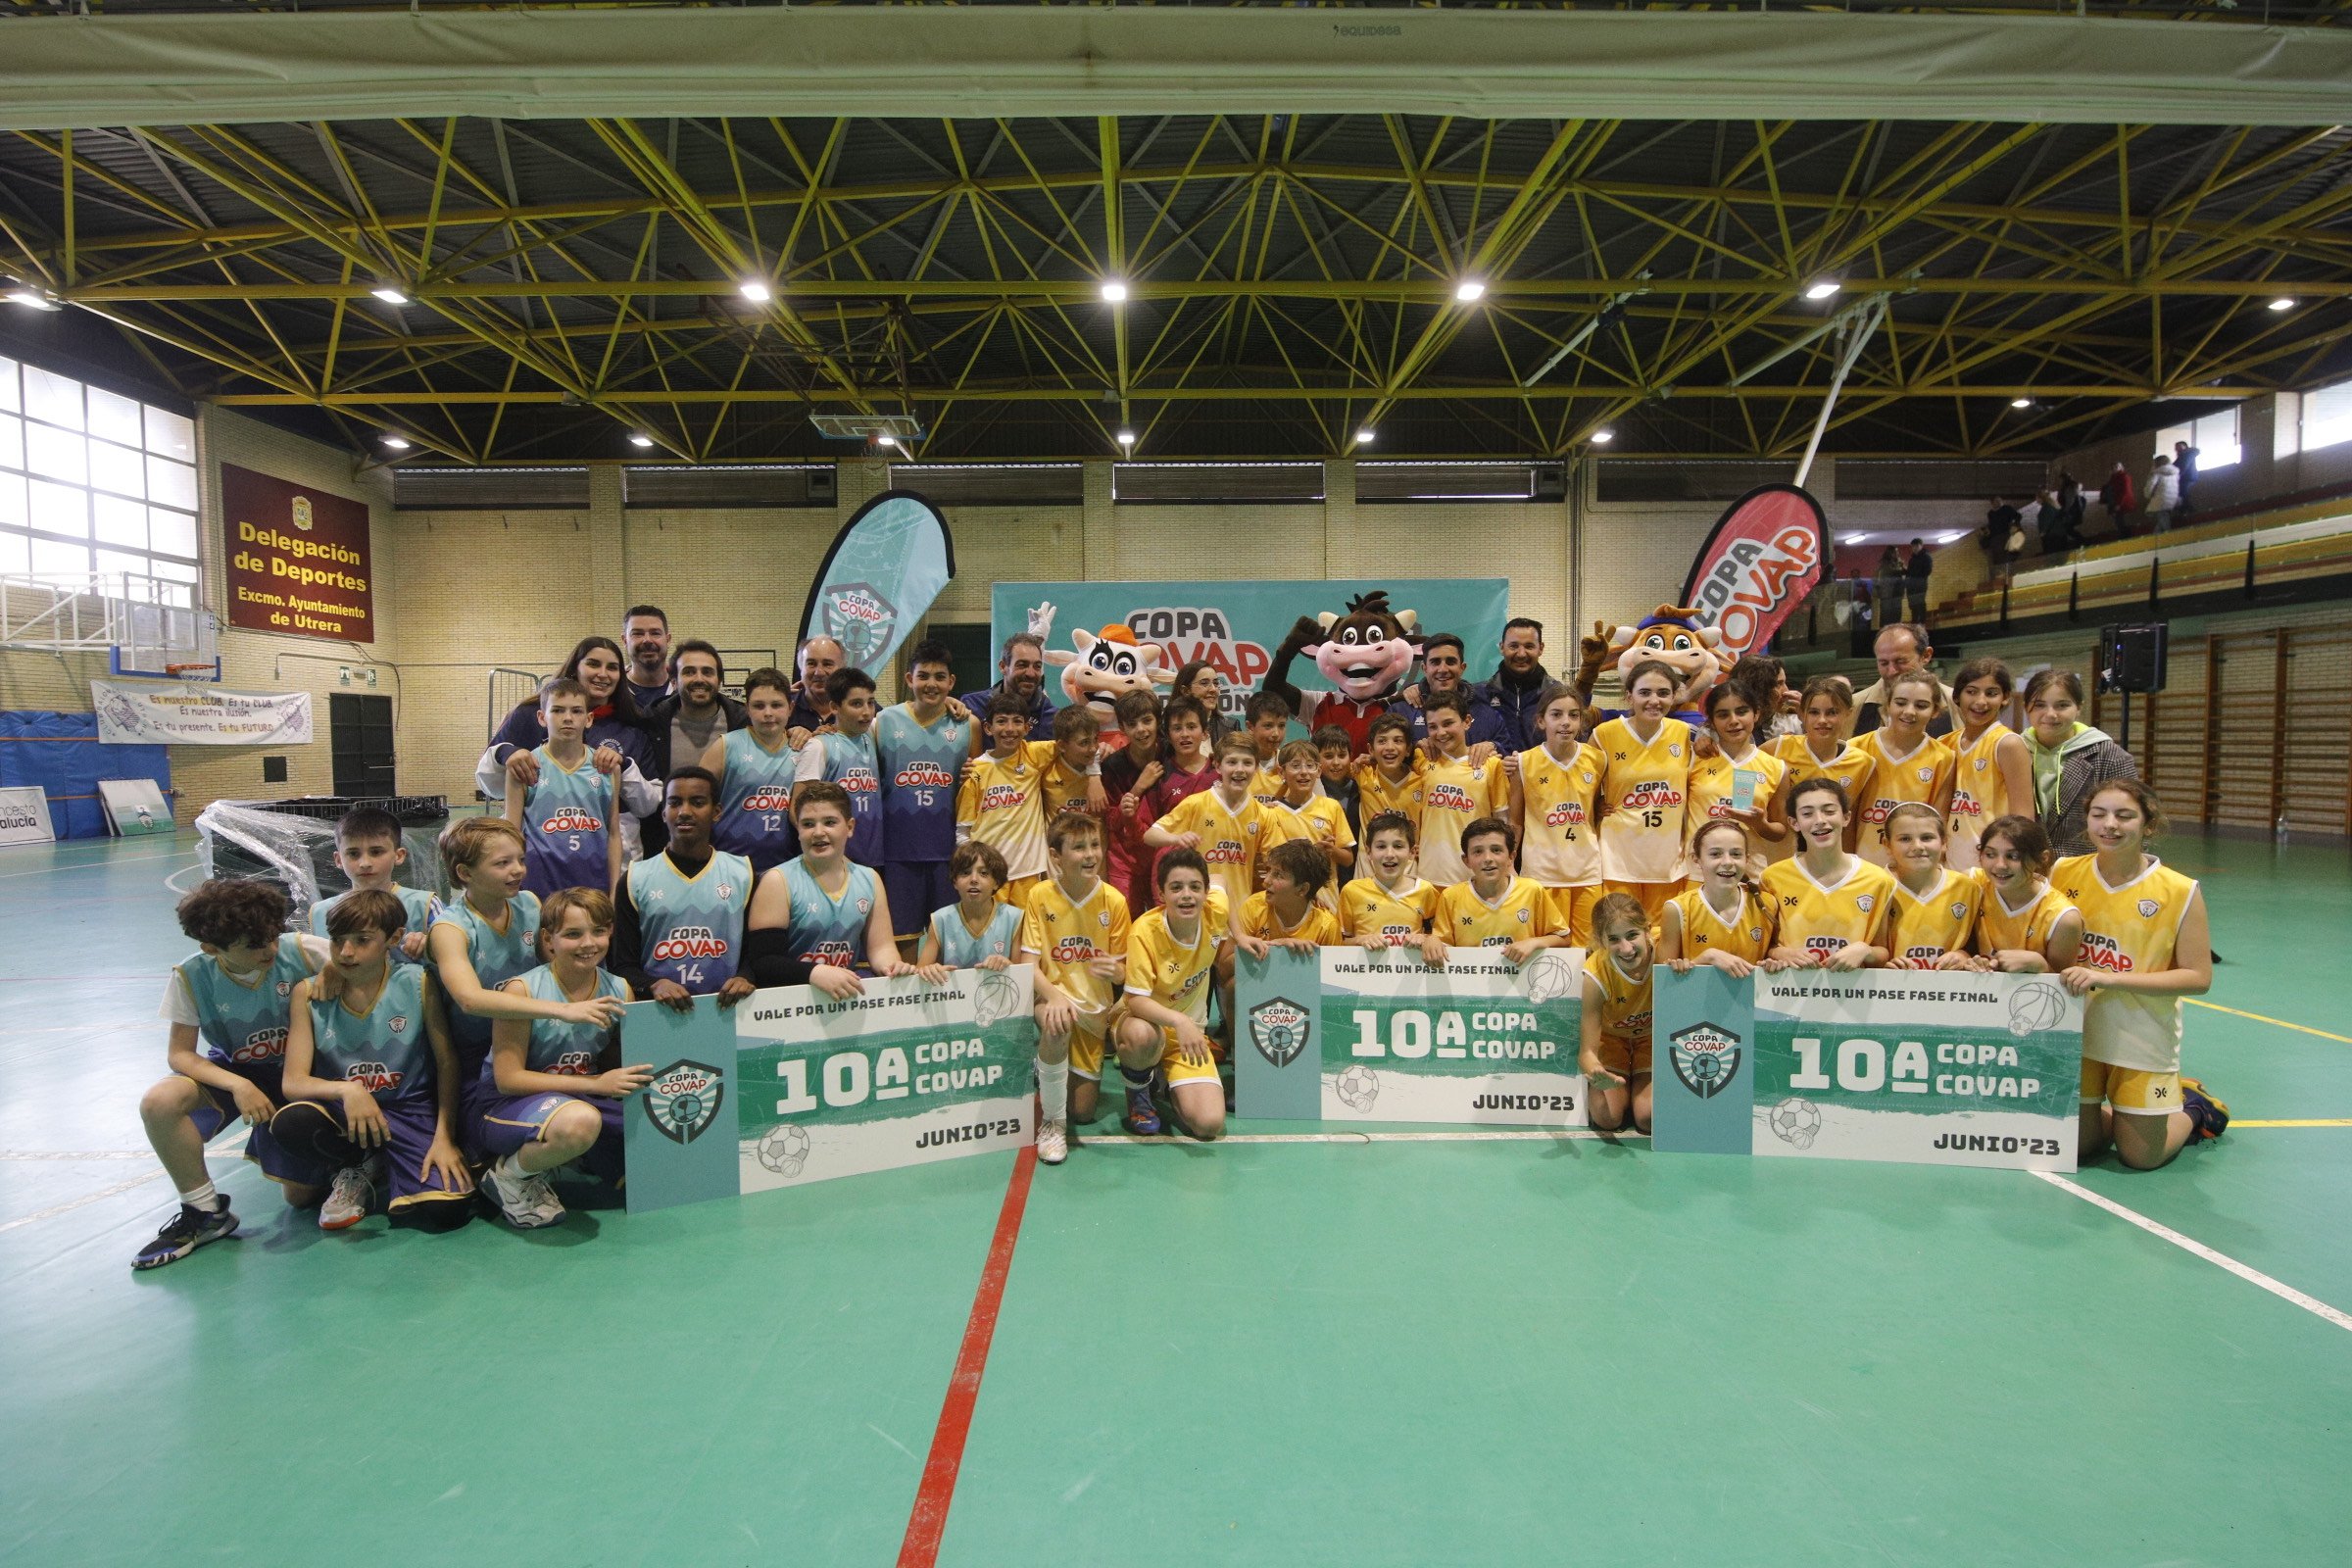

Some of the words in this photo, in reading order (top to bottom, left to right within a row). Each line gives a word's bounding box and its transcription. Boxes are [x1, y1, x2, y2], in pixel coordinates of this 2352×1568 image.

[239, 521, 361, 565] Delegación
[234, 551, 265, 572] de
[271, 557, 367, 592] Deportes
[1694, 543, 1763, 627] COPA
[238, 586, 286, 607] Excmo.
[288, 595, 366, 618] Ayuntamiento
[850, 595, 874, 610] COPA
[839, 601, 881, 621] COVAP
[270, 612, 290, 626] de
[295, 614, 342, 633] Utrera
[1128, 612, 1226, 639] COPA
[1140, 642, 1269, 685] VAP
[149, 695, 161, 704] Es
[164, 696, 198, 705] nuestro
[180, 706, 189, 715] Es
[191, 707, 222, 716] nuestra
[179, 723, 216, 734] presente.
[219, 722, 227, 731] Es
[909, 762, 940, 771] COPA
[895, 771, 953, 786] COVAP
[758, 786, 788, 796] COPA
[988, 785, 1014, 796] COPA
[1436, 785, 1464, 796] COPA
[1636, 782, 1669, 792] COPA
[744, 796, 790, 810] COVA
[914, 790, 934, 806] 15
[1428, 793, 1474, 810] COVAP
[1623, 791, 1682, 808] COVAP
[1953, 791, 1970, 800] PA
[856, 796, 868, 812] 11
[1875, 800, 1896, 808] COP
[1951, 800, 1981, 815] VAP
[557, 808, 587, 817] COPA
[1642, 811, 1663, 828] 15
[543, 817, 601, 832] COVAP
[761, 815, 781, 831] 12
[1565, 828, 1576, 841] 4
[568, 835, 580, 851] 5
[671, 929, 710, 940] COPA
[1061, 937, 1092, 948] COPA
[1483, 937, 1513, 947] COPA
[2082, 932, 2117, 951] OPA
[654, 940, 726, 959] COVAP
[818, 942, 849, 953] COPA
[1806, 938, 1847, 948] COPA
[1906, 948, 1944, 957] COPA
[2078, 944, 2132, 971] OVAP
[676, 964, 705, 984] 14
[1335, 964, 1365, 973] VALE
[1369, 964, 1393, 973] POR
[1448, 965, 1477, 975] FASE
[1481, 965, 1519, 975] FINAL
[1771, 987, 1808, 998] VALE
[1812, 988, 1841, 999] POR
[1844, 989, 1864, 999] UN
[1869, 990, 1905, 1000] PASE
[1909, 991, 1945, 1002] FASE
[1950, 992, 1998, 1004] FINAL
[754, 1007, 791, 1021] VALE
[796, 1004, 824, 1016] POR
[828, 1002, 847, 1013] UN
[851, 998, 885, 1011] PASE
[889, 994, 921, 1007] FASE
[924, 990, 965, 1004] FINAL
[1261, 1015, 1298, 1024] COVAP
[1472, 1011, 1538, 1031] COPA
[249, 1028, 288, 1045] COPA
[232, 1039, 287, 1063] COV
[915, 1038, 984, 1064] COPA
[1472, 1040, 1556, 1059] COVAP
[1685, 1042, 1726, 1052] COVAP
[1936, 1044, 2019, 1066] COPA
[348, 1064, 385, 1075] COPA
[350, 1073, 404, 1092] OVAP
[669, 1073, 698, 1083] COPA
[915, 1065, 1003, 1095] COVAP
[661, 1079, 707, 1095] COVAP
[1936, 1074, 2040, 1099] COVAP
